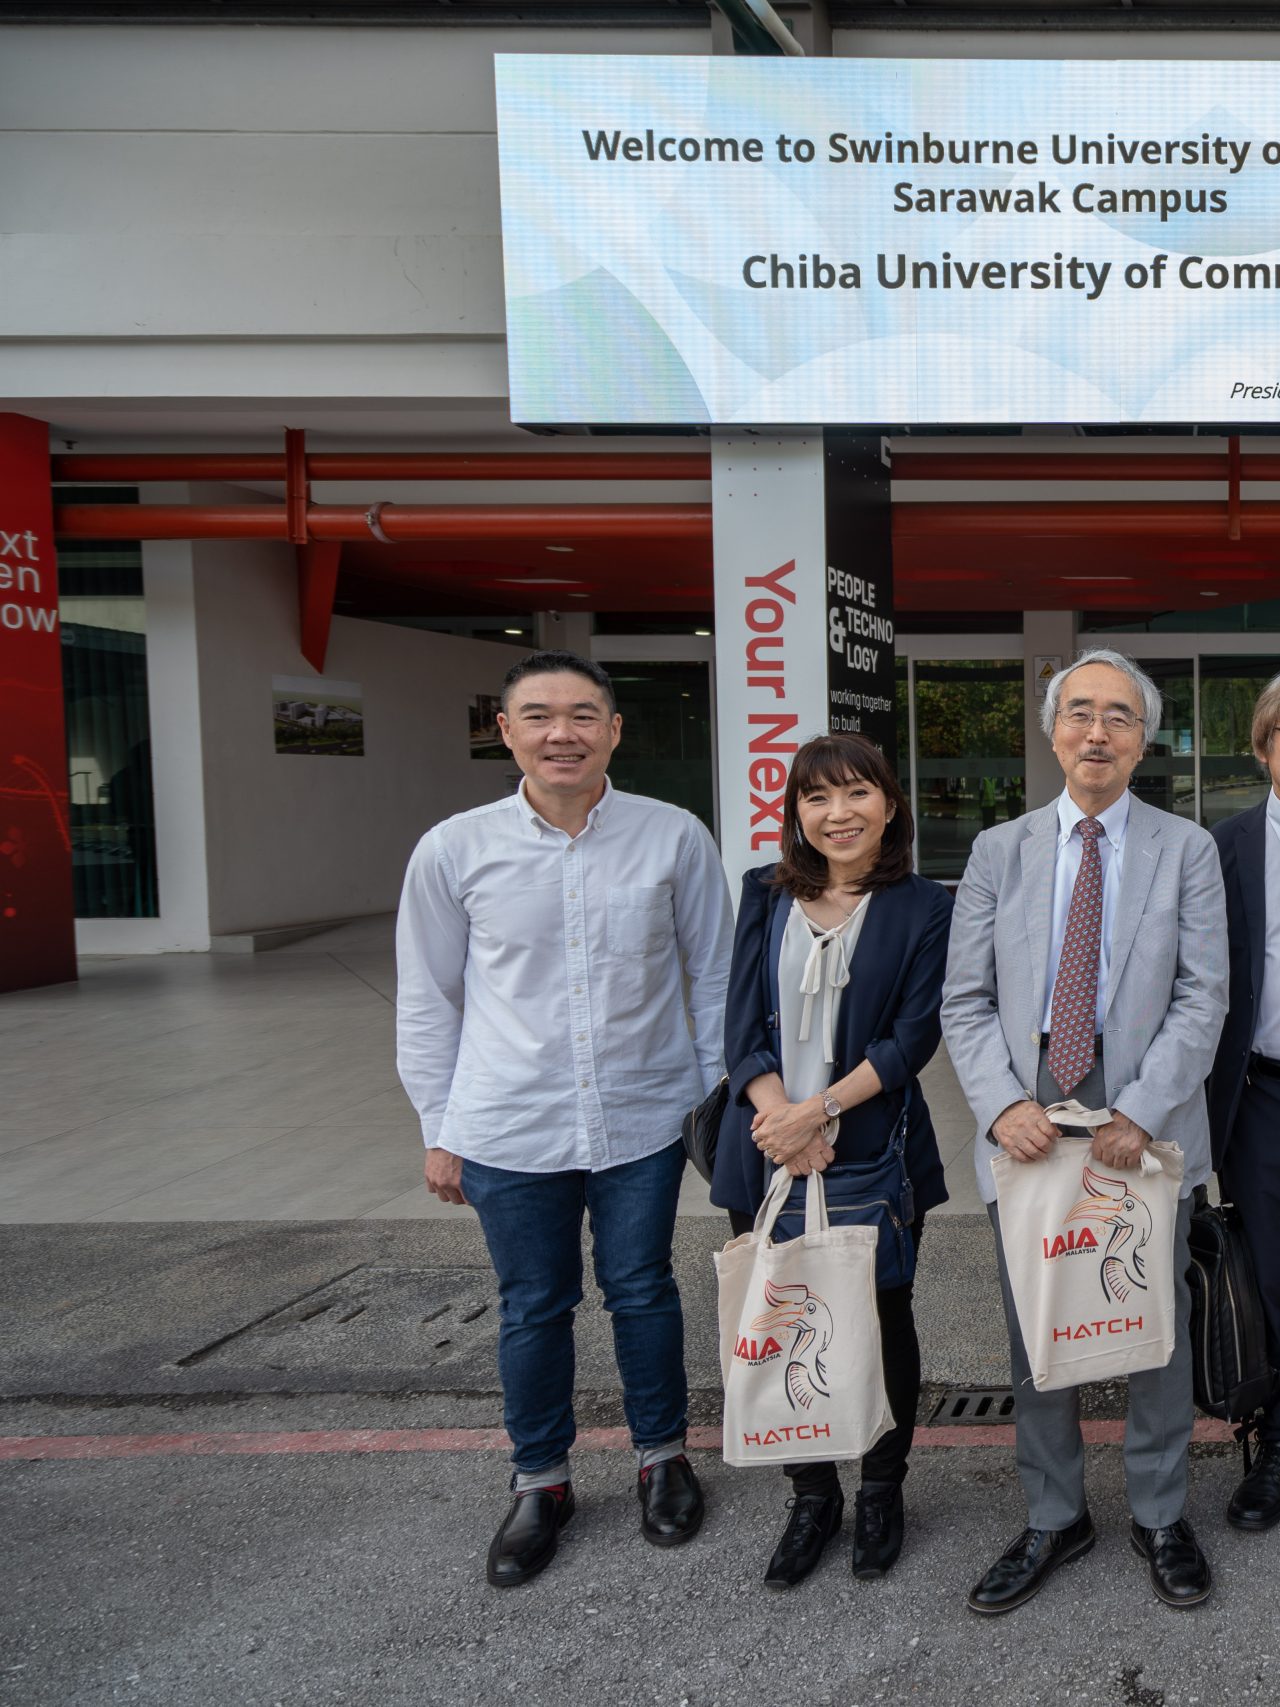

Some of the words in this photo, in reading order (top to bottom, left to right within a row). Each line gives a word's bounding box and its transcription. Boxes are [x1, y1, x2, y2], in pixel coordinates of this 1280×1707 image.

[583, 130, 763, 163] Welcome
[776, 134, 815, 163] to
[828, 132, 1038, 165] Swinburne
[1052, 133, 1251, 174] University
[893, 182, 1061, 213] Sarawak
[1072, 183, 1228, 222] Campus
[743, 254, 861, 289] Chiba
[877, 252, 1112, 300] University
[1124, 255, 1169, 289] of
[827, 566, 876, 608] PEOPLE
[744, 559, 797, 699] Your
[829, 606, 847, 654] &
[845, 606, 894, 645] TECHNO
[846, 641, 879, 674] LOGY
[830, 689, 861, 711] working
[862, 692, 892, 713] together
[831, 715, 840, 730] to
[841, 716, 861, 733] build
[748, 714, 799, 851] Next
[1043, 1227, 1099, 1260] IAIA
[1065, 1247, 1097, 1258] MALAYSIA
[1053, 1315, 1143, 1342] HATCH
[747, 1352, 782, 1367] MALAYSIA
[743, 1423, 831, 1446] HATCH
